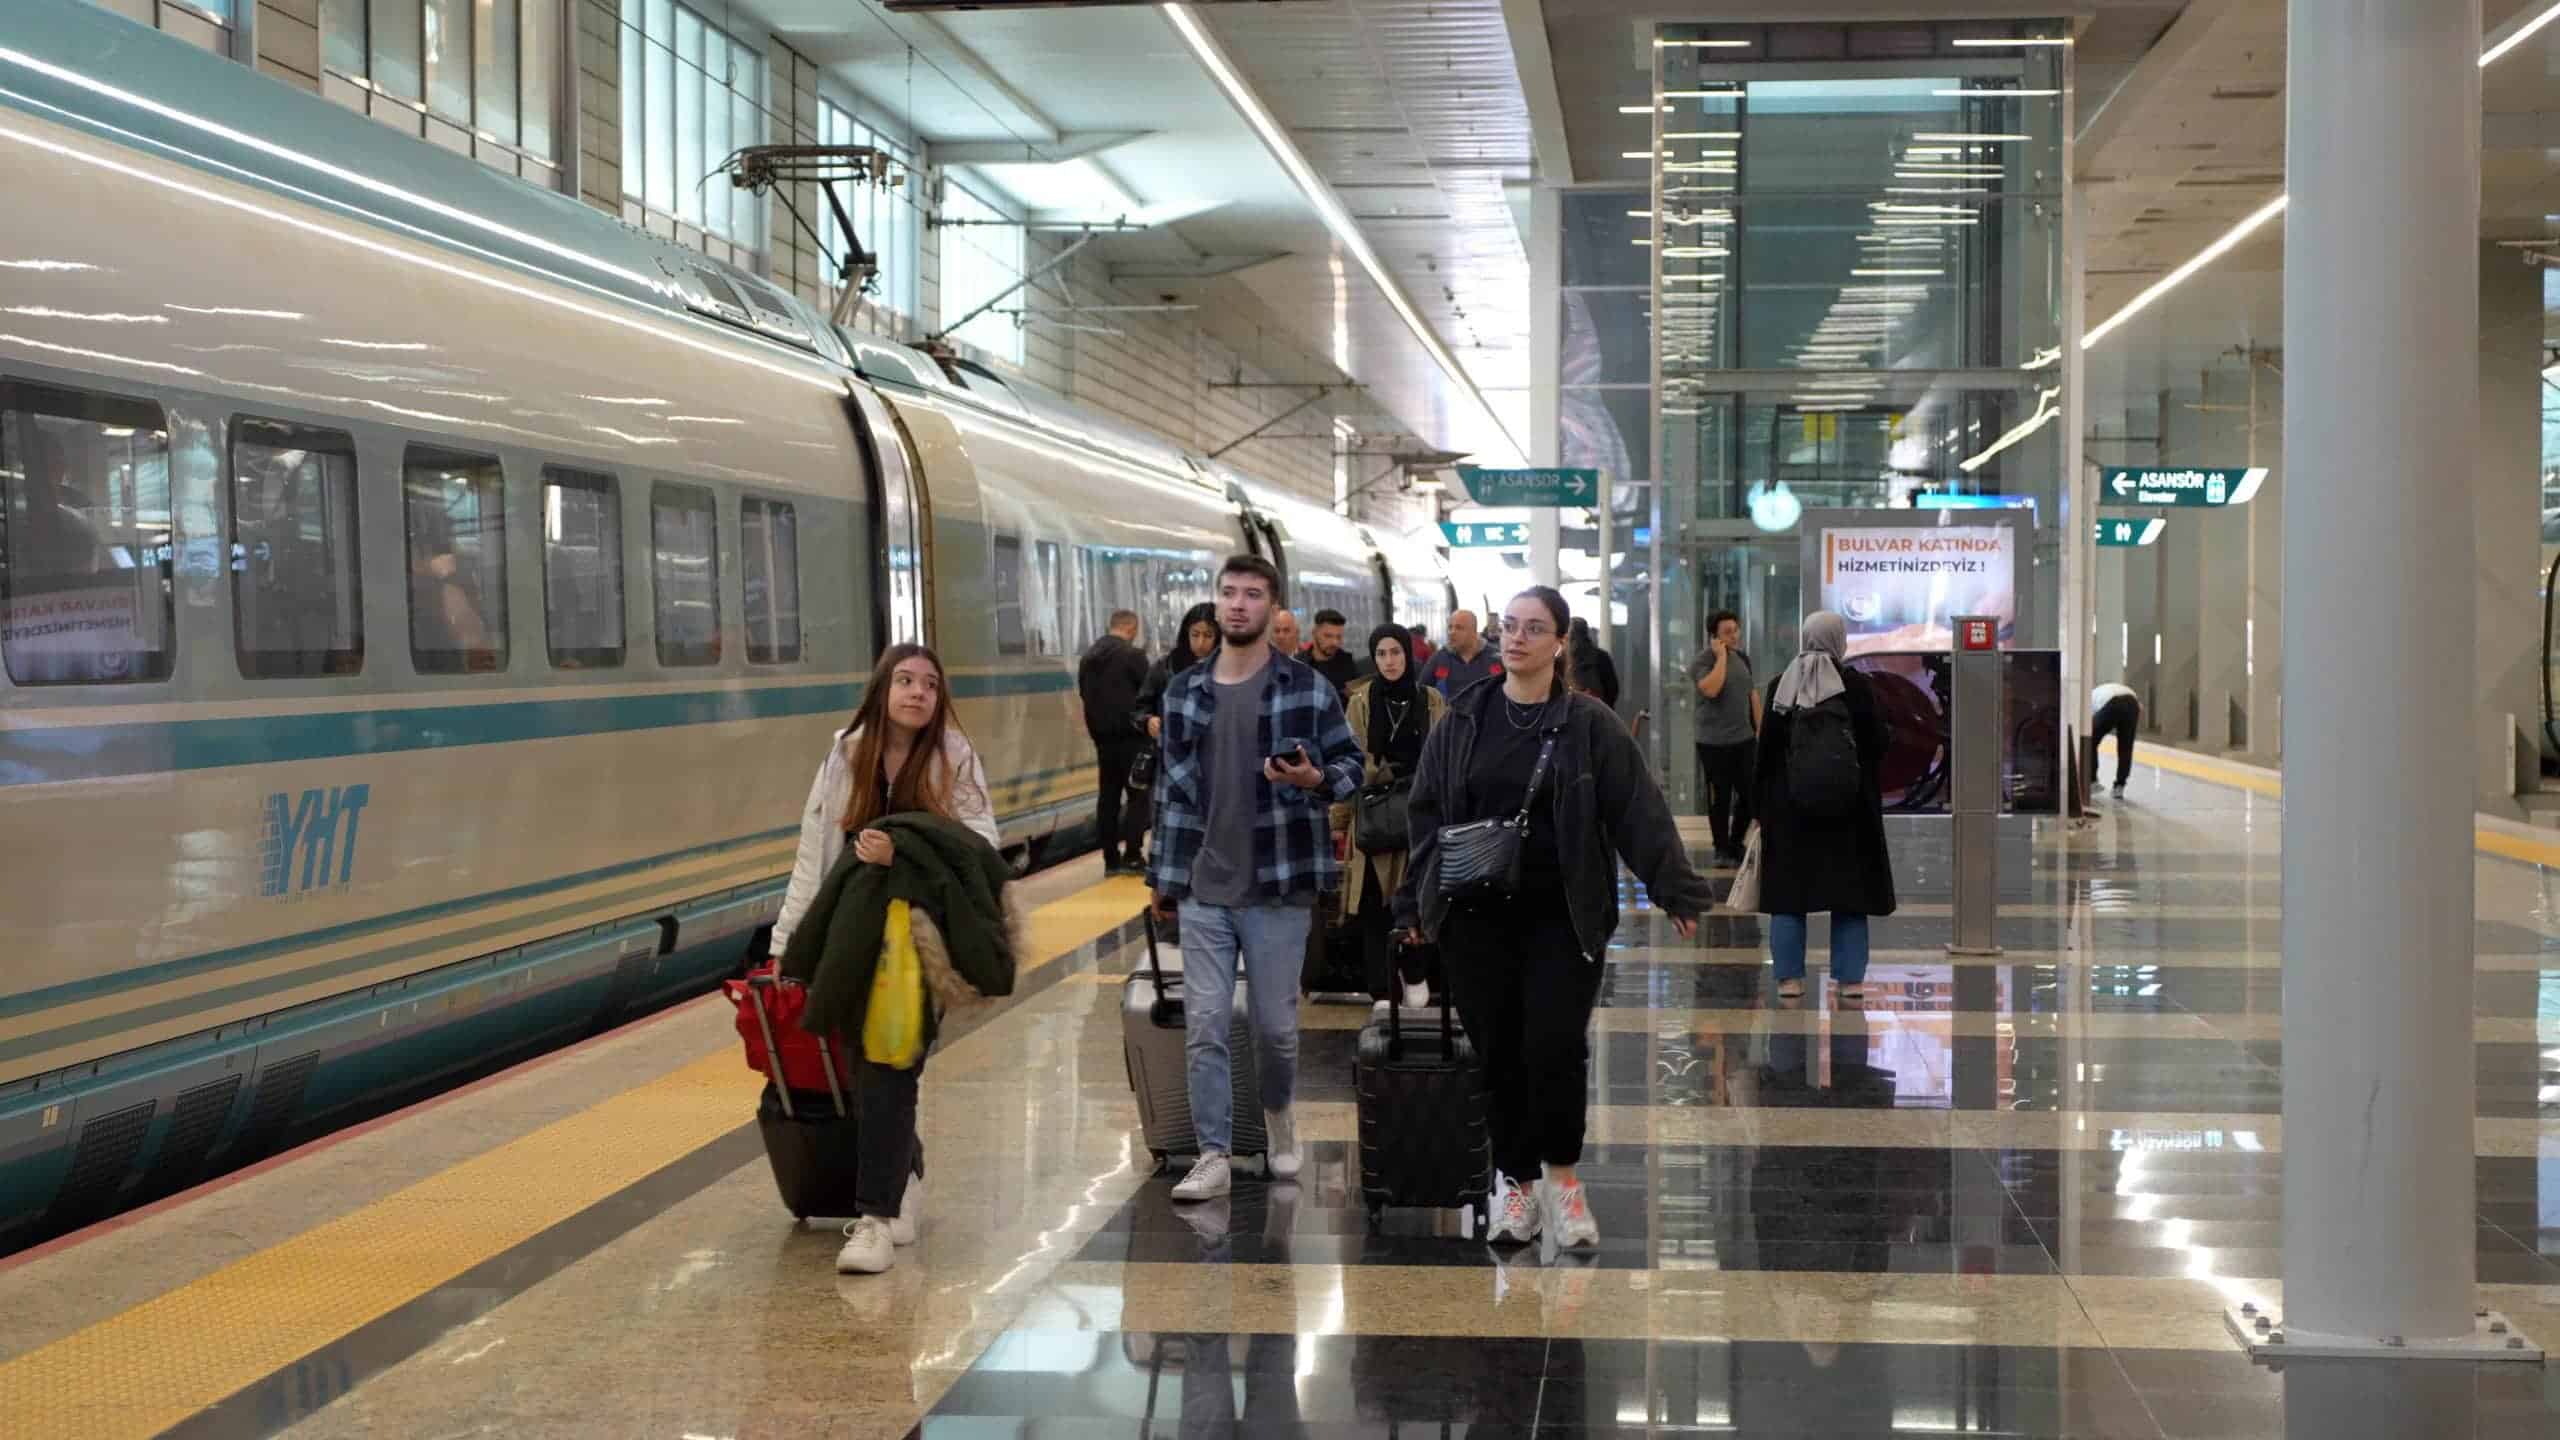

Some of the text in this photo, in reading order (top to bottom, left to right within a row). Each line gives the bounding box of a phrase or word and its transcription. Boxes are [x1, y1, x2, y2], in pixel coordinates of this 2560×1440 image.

[2138, 470, 2205, 489] ASANSÖR
[1838, 538, 2001, 552] BULVAR KATINDA
[269, 783, 371, 897] YHT
